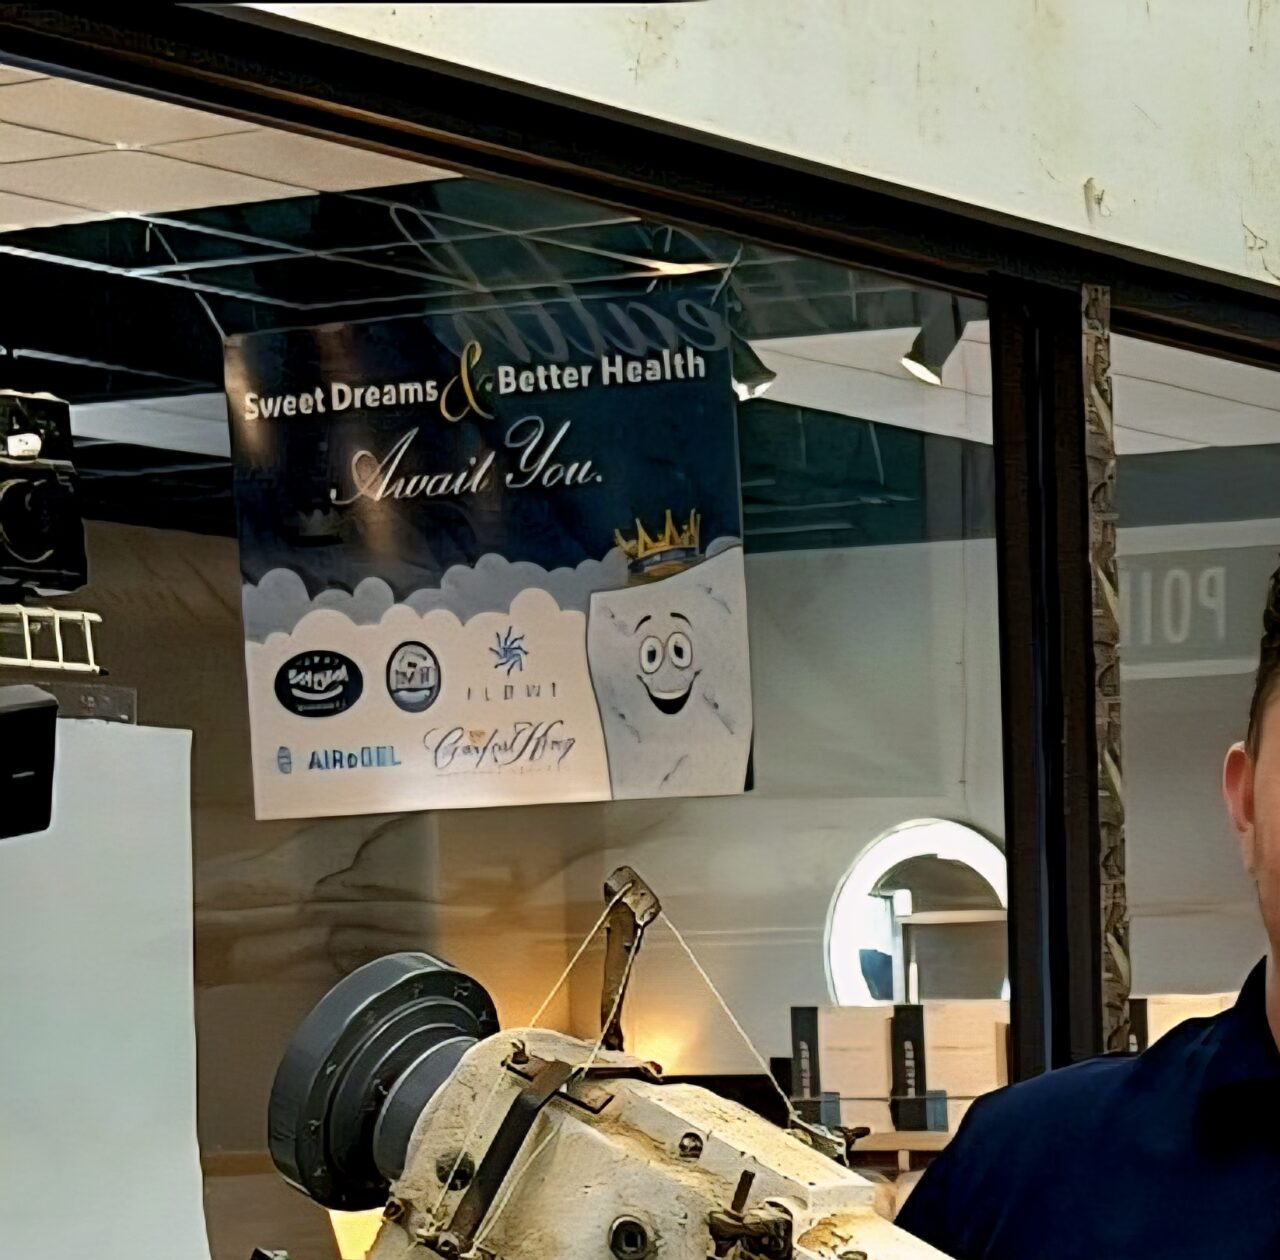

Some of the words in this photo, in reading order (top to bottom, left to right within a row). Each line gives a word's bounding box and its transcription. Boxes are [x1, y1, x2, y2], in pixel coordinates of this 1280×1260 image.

[244, 388, 326, 421] Sweet
[331, 379, 439, 411] Dreams
[440, 340, 495, 422] &
[497, 364, 592, 395] Better
[601, 346, 706, 386] Health
[330, 426, 496, 505] Await
[504, 415, 603, 488] You.
